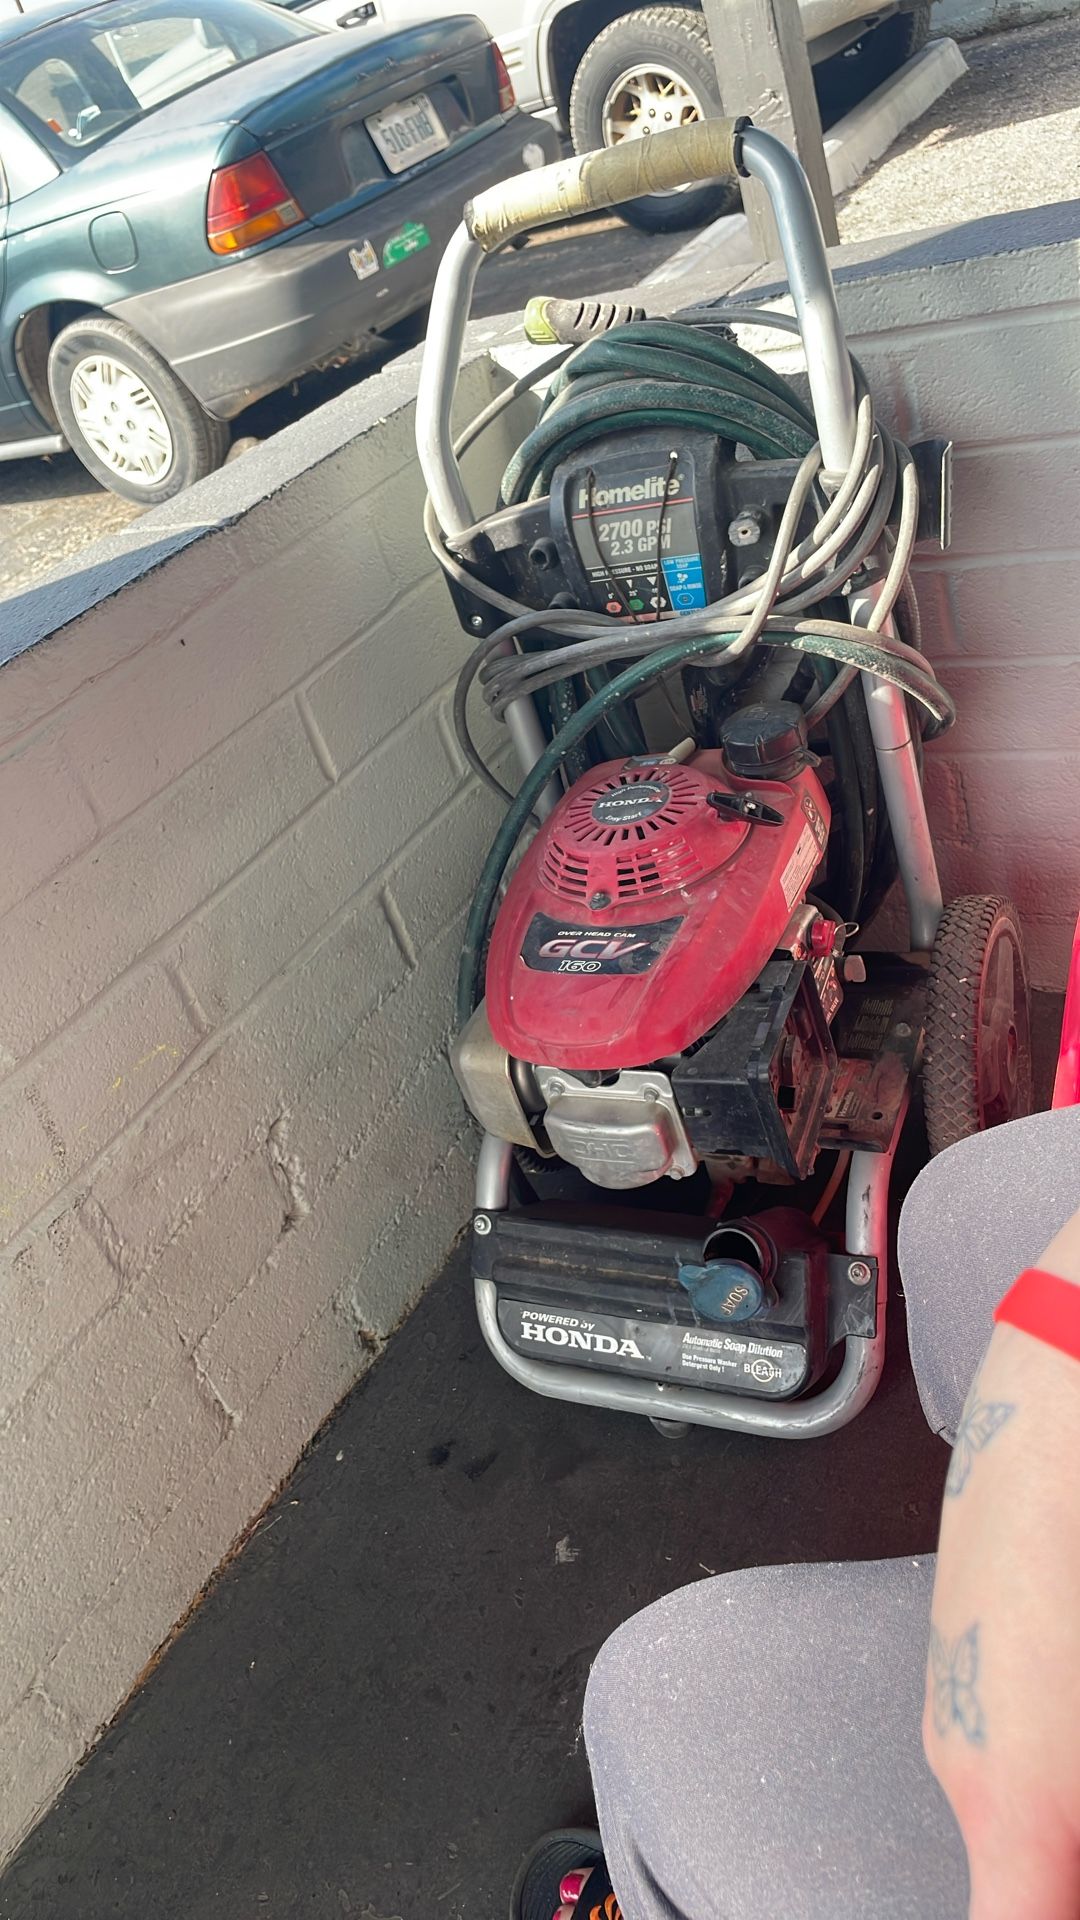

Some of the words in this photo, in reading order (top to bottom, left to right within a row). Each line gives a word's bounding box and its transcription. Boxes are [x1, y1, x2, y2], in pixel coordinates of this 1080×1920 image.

[578, 476, 681, 509] Homelite
[598, 519, 643, 542] 2700
[646, 518, 672, 536] PSI
[610, 539, 634, 556] 2.3
[637, 535, 671, 552] GPM
[591, 569, 605, 578] HIGH
[635, 564, 644, 572] NO
[643, 562, 658, 571] SOAP
[598, 797, 663, 808] HONDA
[605, 814, 621, 823] Easy
[622, 811, 642, 821] Start
[538, 938, 650, 960] GCV
[558, 959, 602, 972] 160
[721, 1285, 749, 1316] SOAP
[522, 1310, 579, 1327] POWERED
[580, 1320, 595, 1331] by
[520, 1321, 645, 1359] HONDA
[682, 1332, 723, 1349] Automatic
[723, 1338, 747, 1354] Soap
[747, 1342, 783, 1358] Dilution
[682, 1353, 692, 1361] Use
[692, 1354, 717, 1364] Pressure
[717, 1357, 738, 1368] Washer
[682, 1360, 708, 1370] Detergent
[708, 1364, 721, 1373] Only
[743, 1363, 782, 1378] BLEACH
